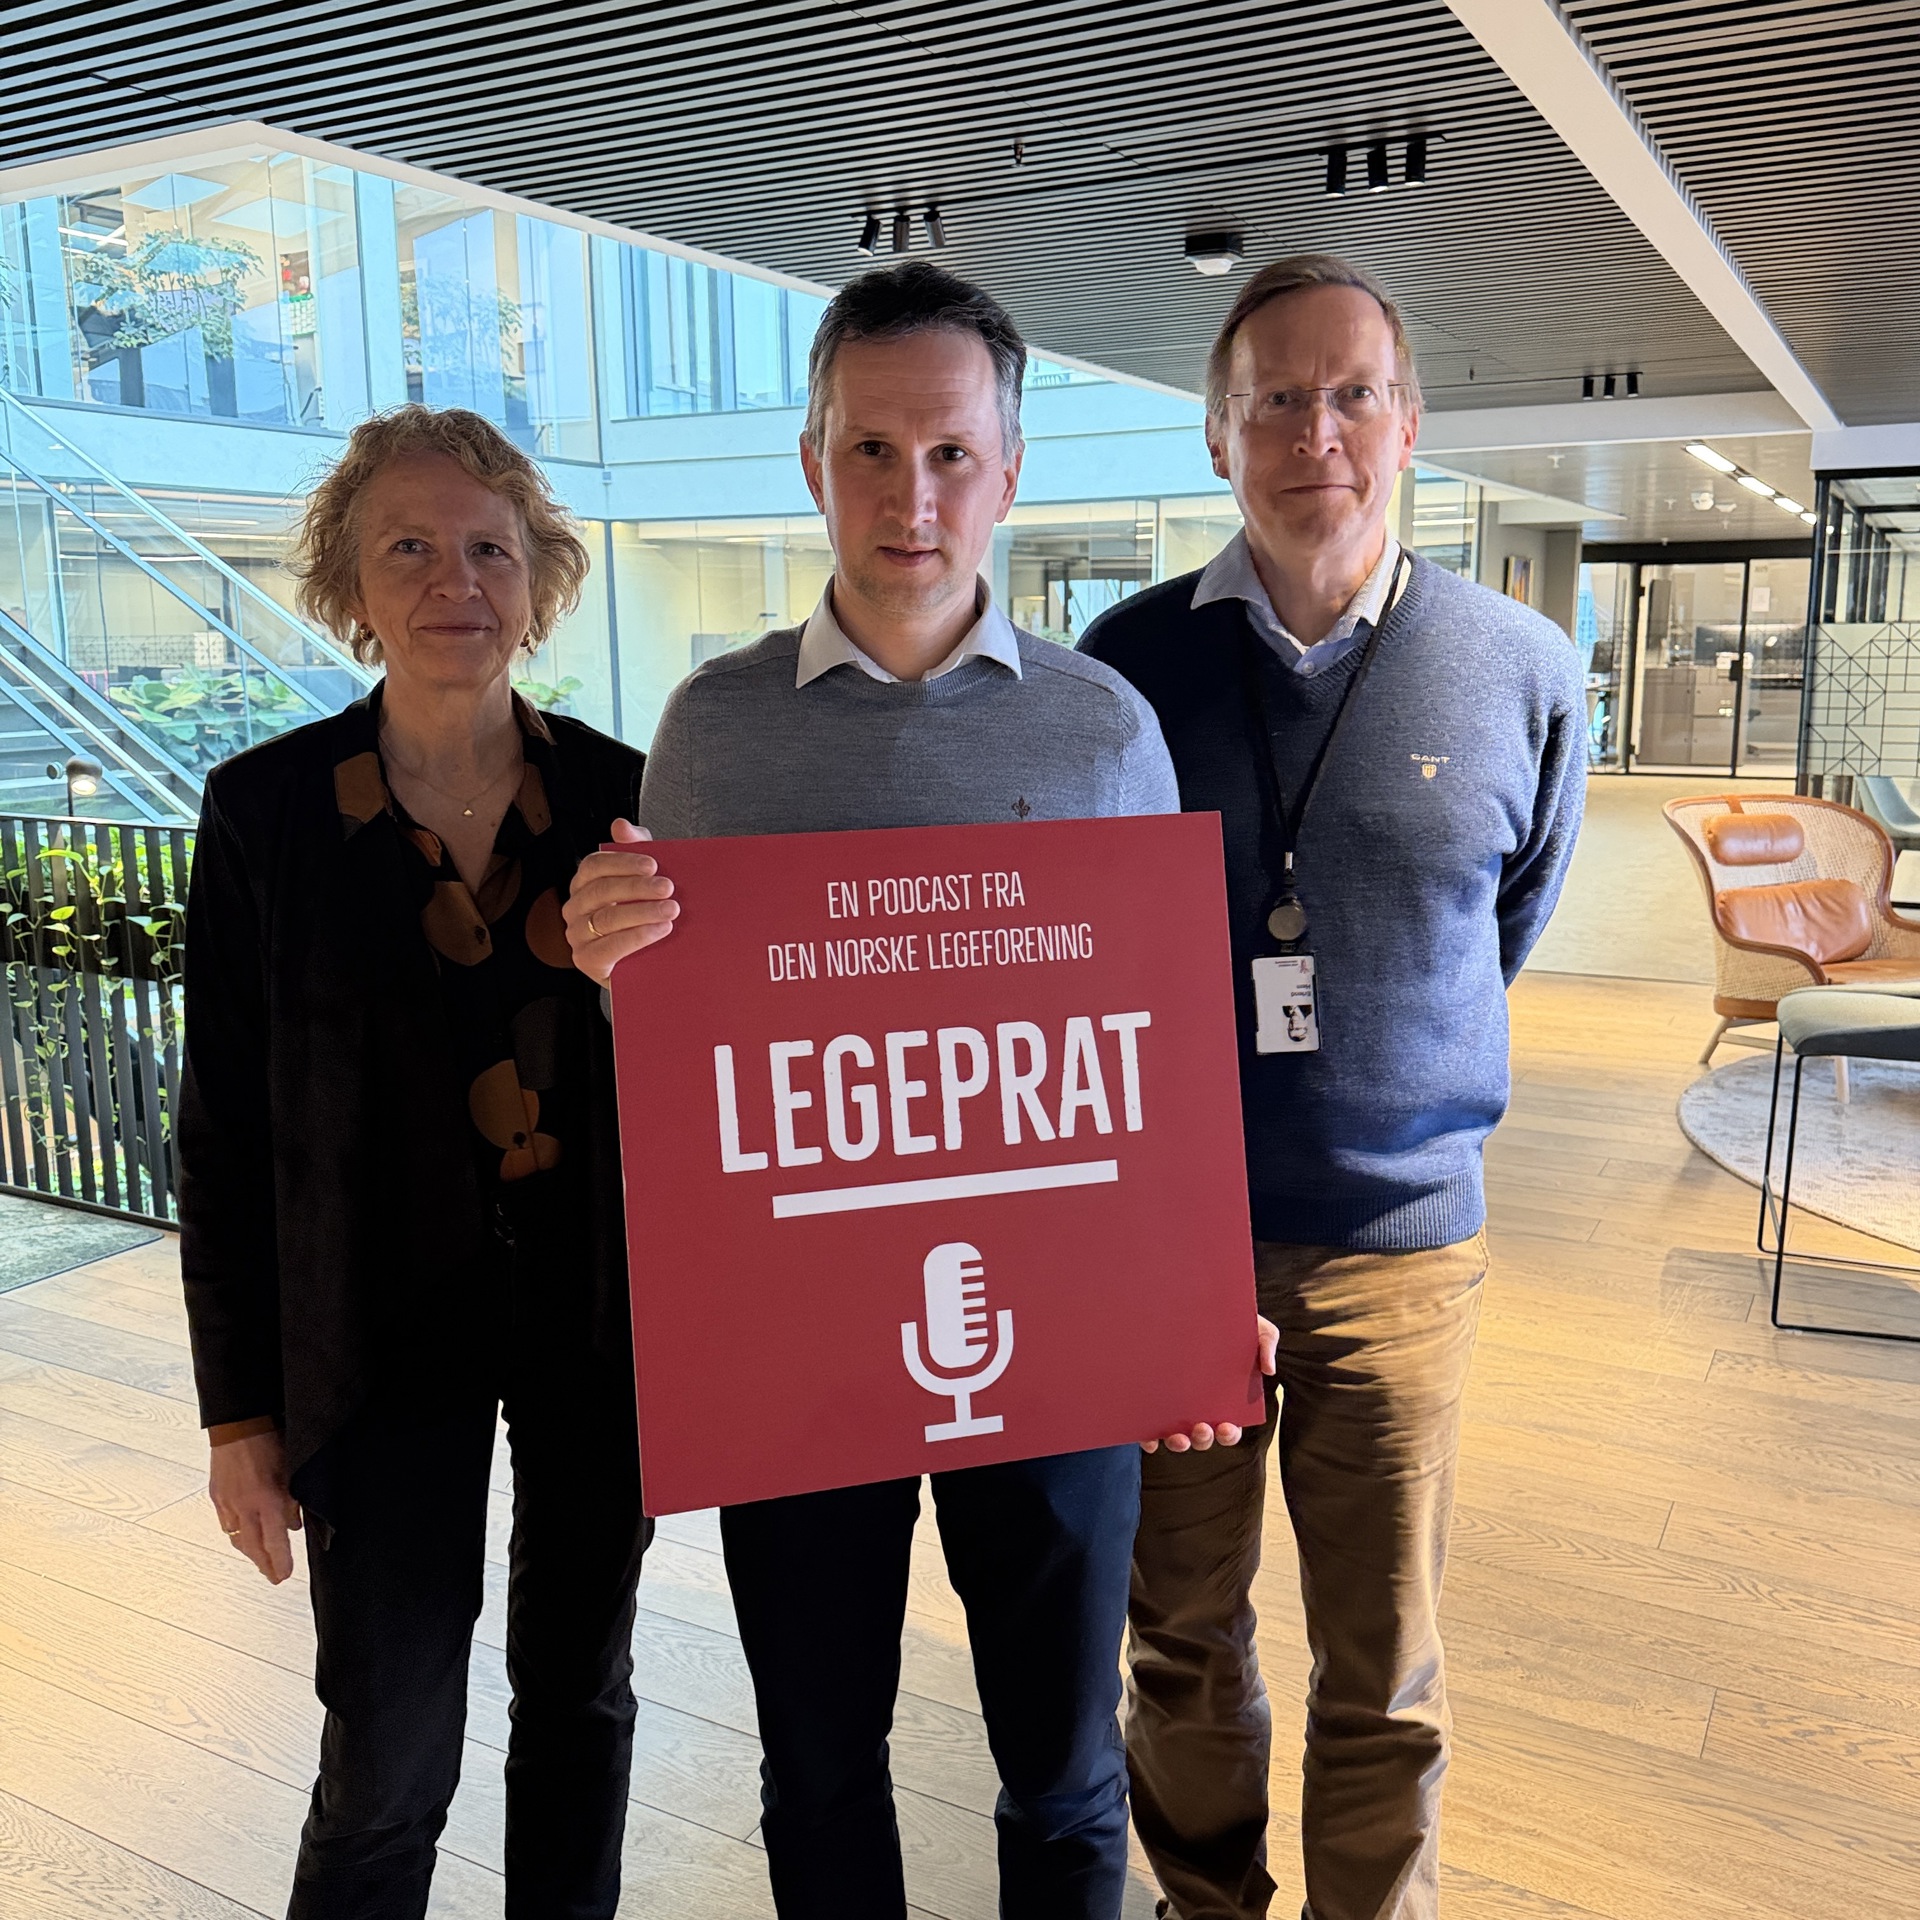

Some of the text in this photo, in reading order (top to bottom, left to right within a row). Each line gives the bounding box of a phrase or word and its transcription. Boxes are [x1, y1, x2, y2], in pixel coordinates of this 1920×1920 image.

[827, 871, 1026, 919] EN PODCAST FRA
[767, 922, 1093, 982] DEN NORSKE LEGEFORENING
[713, 1010, 1152, 1174] LEGEPRAT
